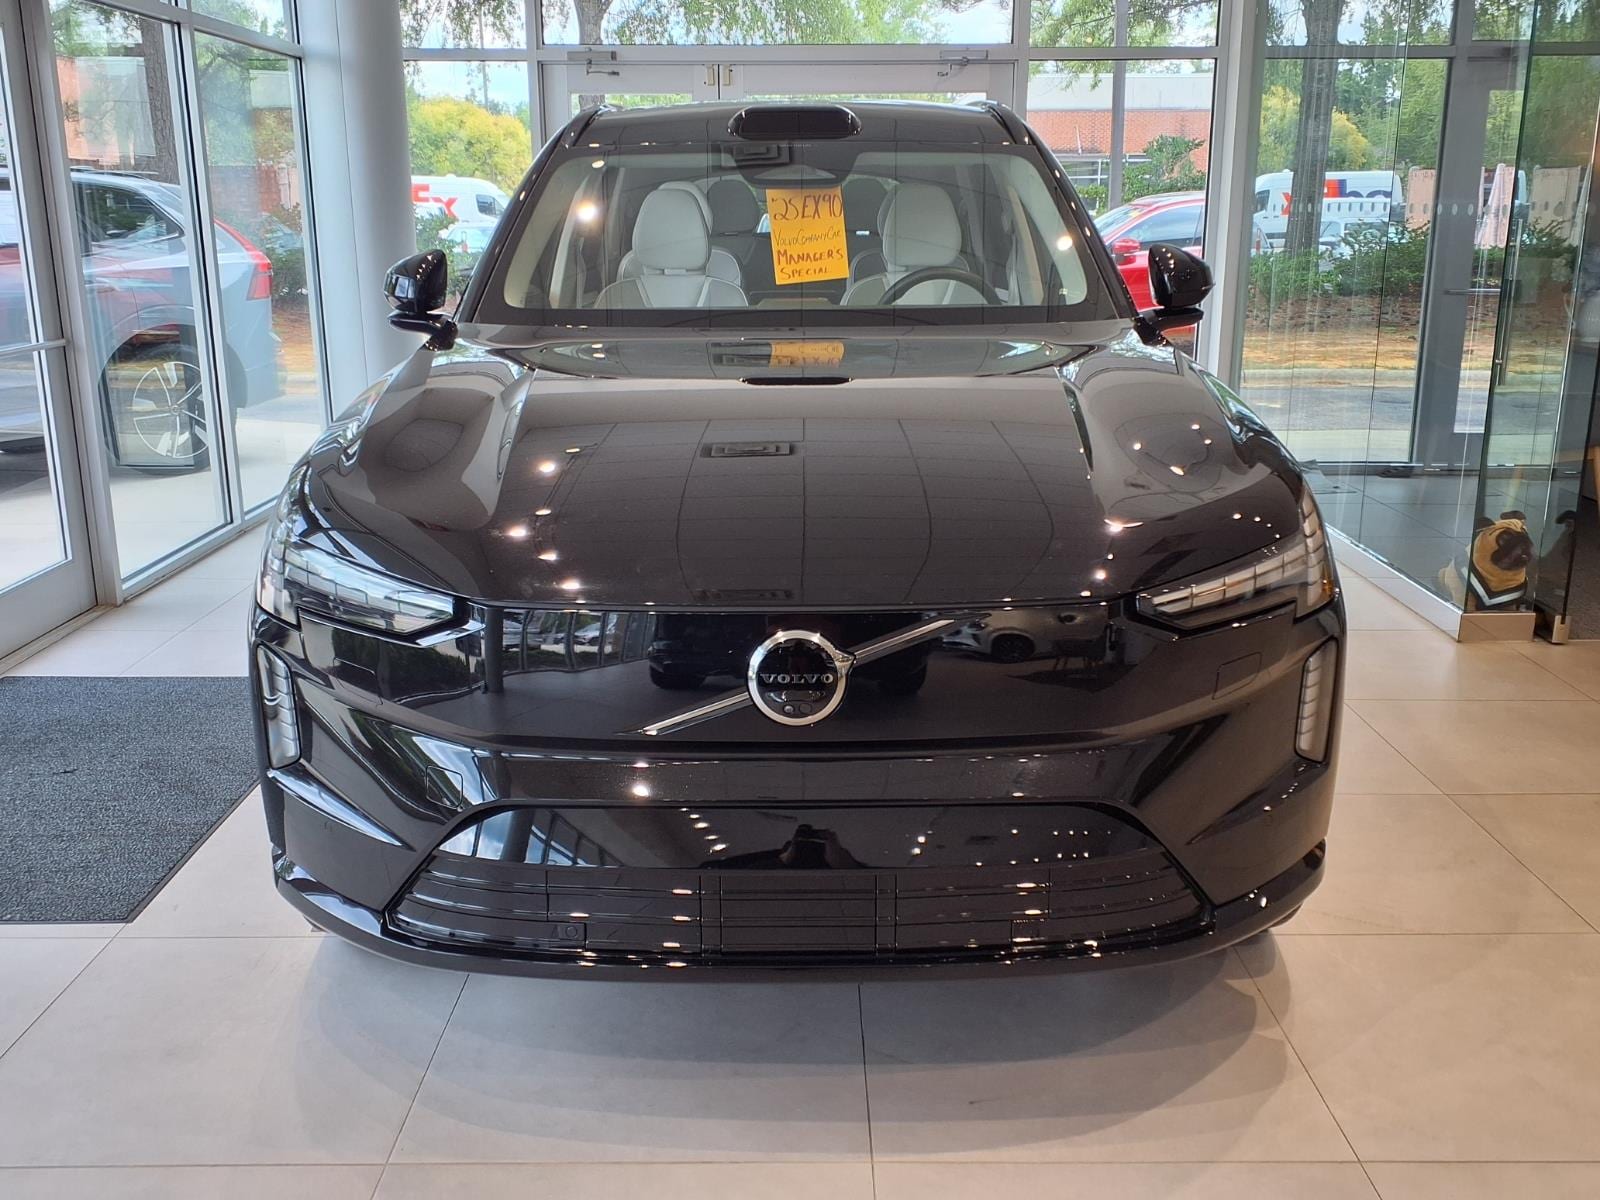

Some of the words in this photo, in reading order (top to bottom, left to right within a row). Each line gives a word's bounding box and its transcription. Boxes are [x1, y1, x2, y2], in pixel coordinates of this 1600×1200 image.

[801, 193, 843, 219] EX90
[780, 266, 829, 280] SPECIAL
[760, 673, 834, 684] VOLVO
